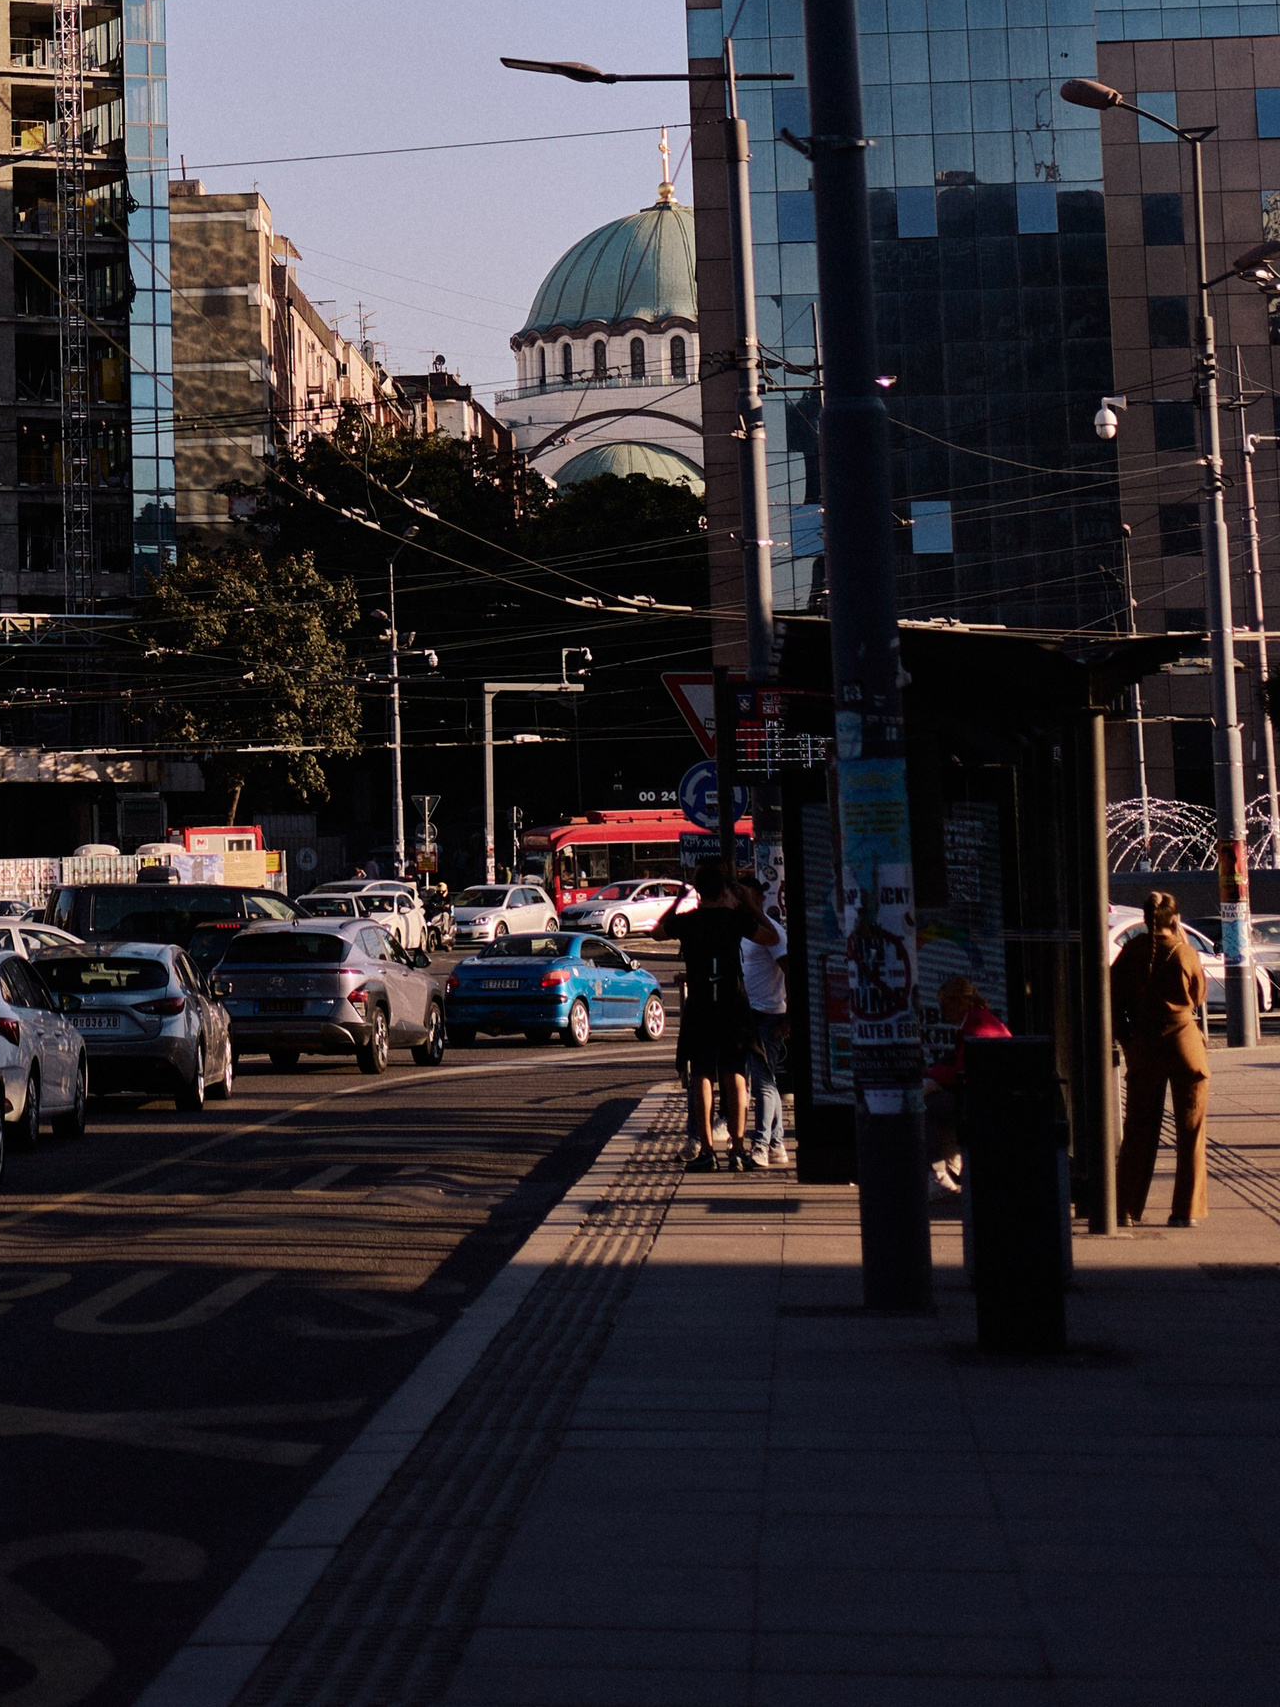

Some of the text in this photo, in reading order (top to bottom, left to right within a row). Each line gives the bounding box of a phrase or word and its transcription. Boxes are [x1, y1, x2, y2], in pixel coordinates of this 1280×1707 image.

[638, 791, 678, 802] 00 24
[857, 1023, 893, 1040] ALTER
